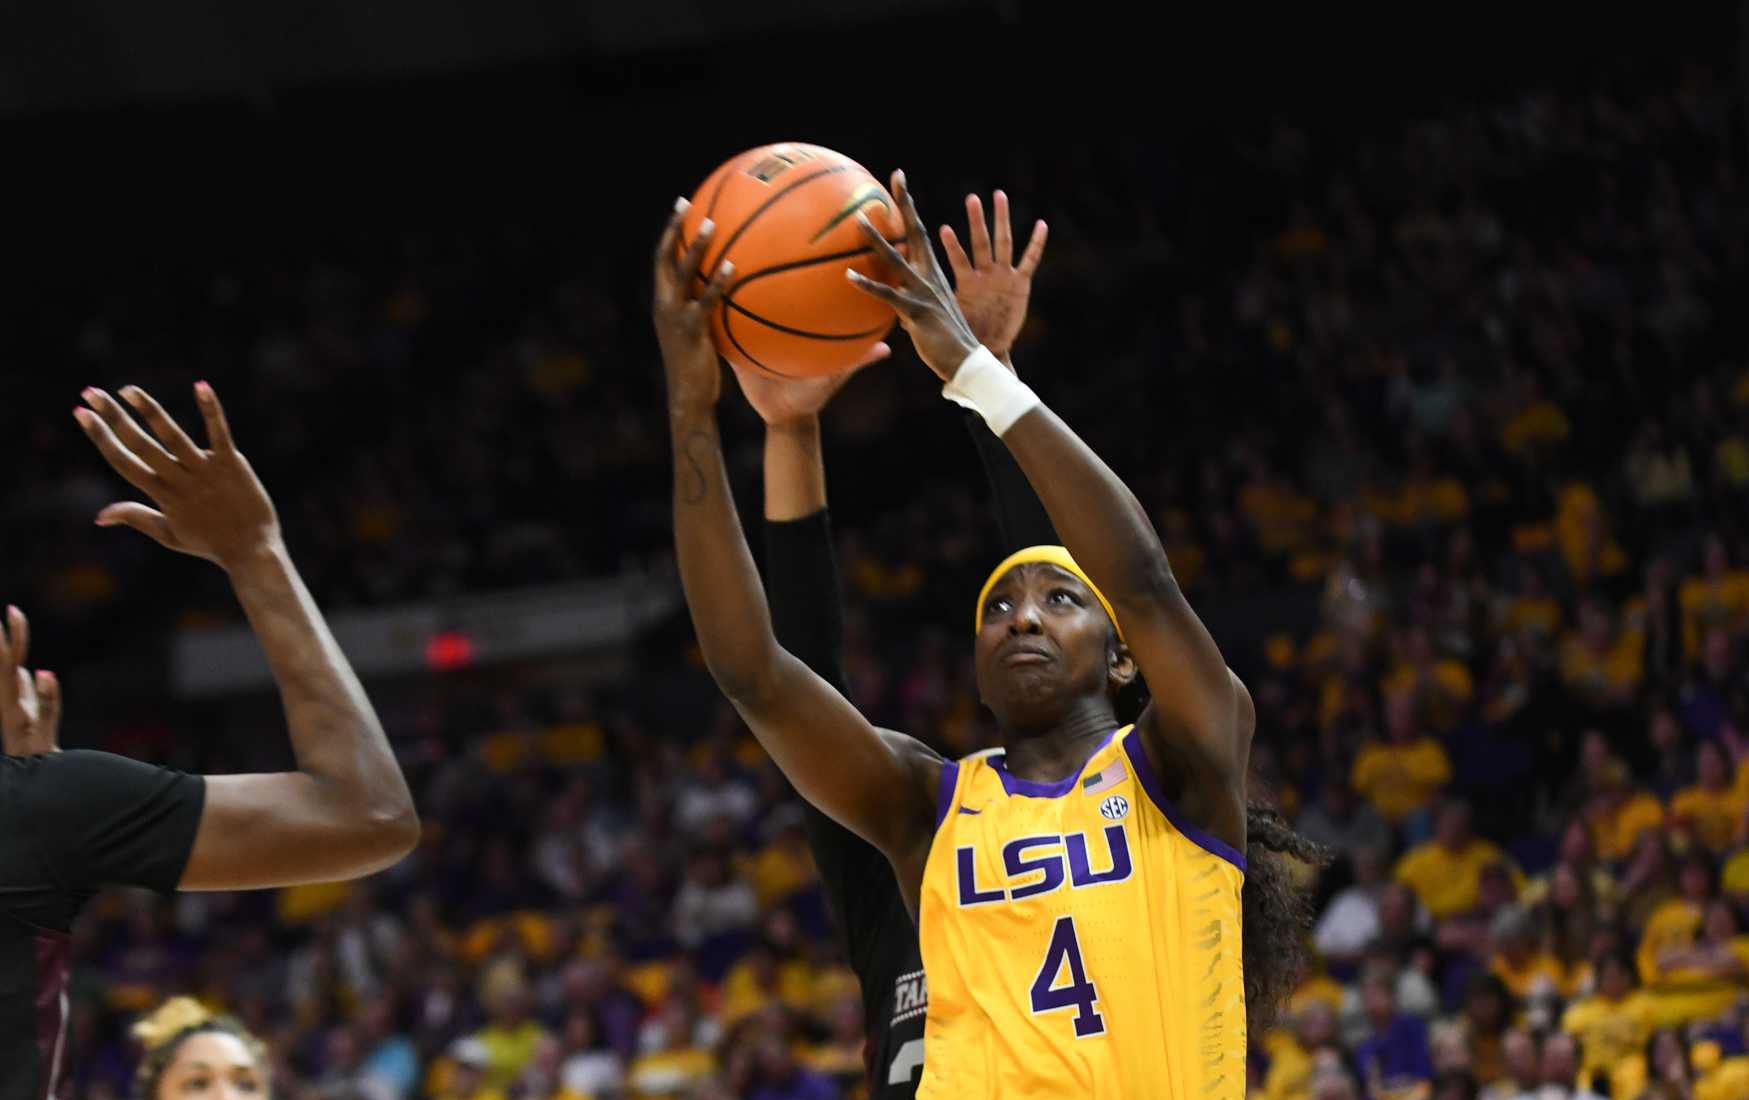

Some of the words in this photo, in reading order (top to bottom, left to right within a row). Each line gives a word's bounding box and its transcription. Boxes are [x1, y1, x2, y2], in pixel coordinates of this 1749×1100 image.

[1101, 797, 1128, 819] SEC
[957, 824, 1133, 906] LSU
[1030, 915, 1105, 1038] 4
